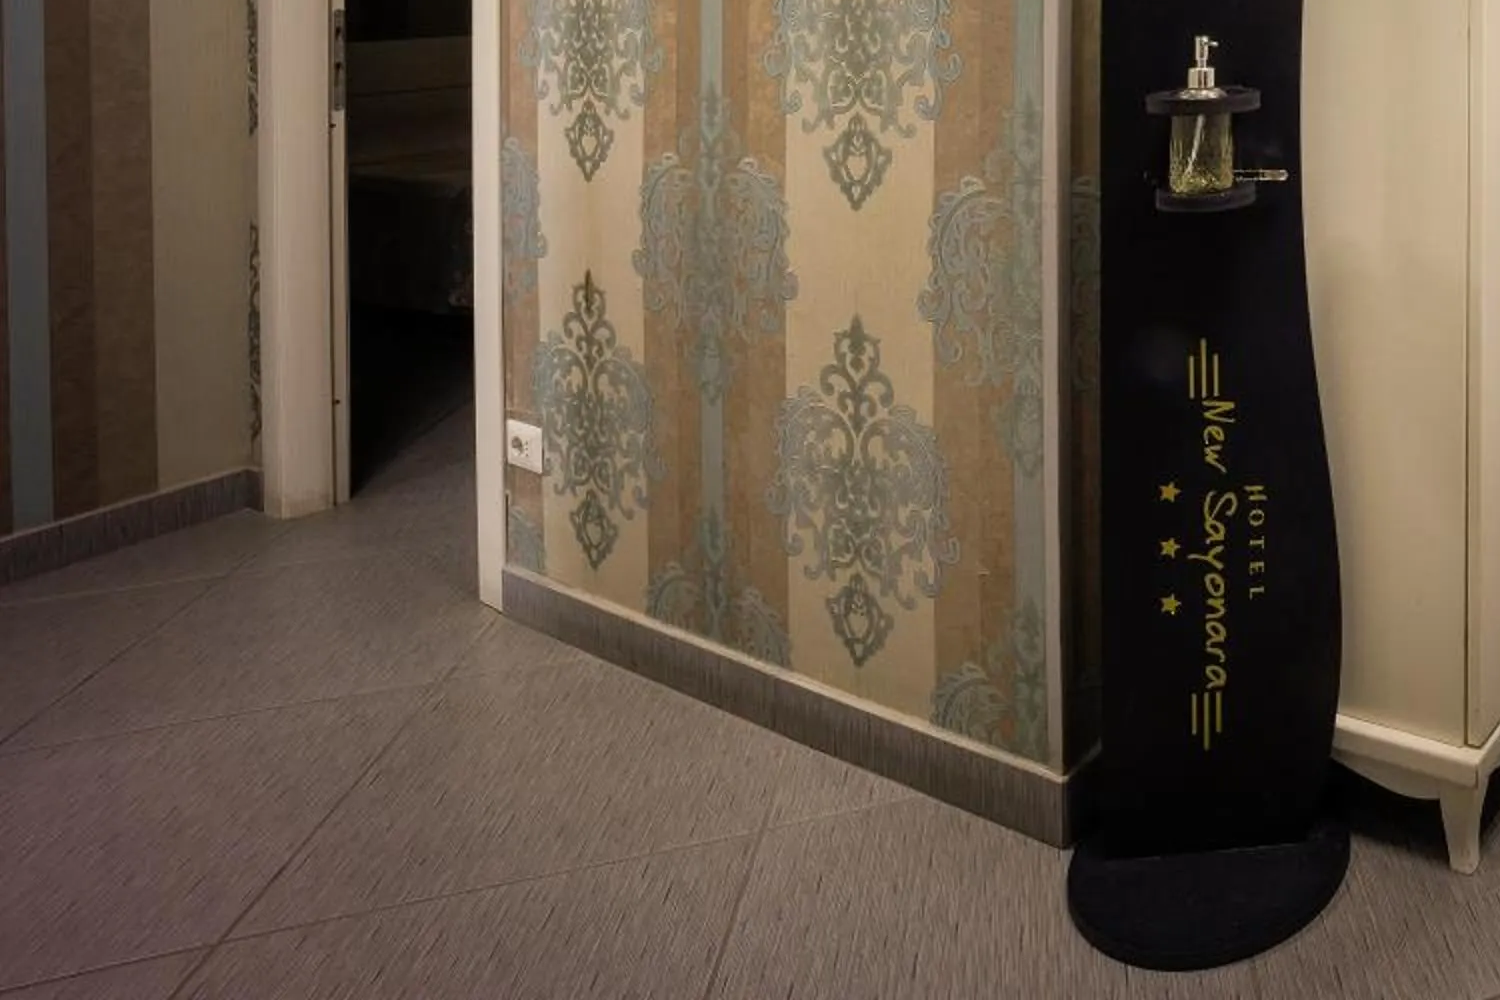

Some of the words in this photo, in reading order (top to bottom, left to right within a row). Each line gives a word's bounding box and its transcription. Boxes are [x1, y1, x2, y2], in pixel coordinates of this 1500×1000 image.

[1202, 399, 1236, 473] New
[1187, 490, 1238, 690] Sayonara
[1244, 484, 1267, 600] HOTEL
